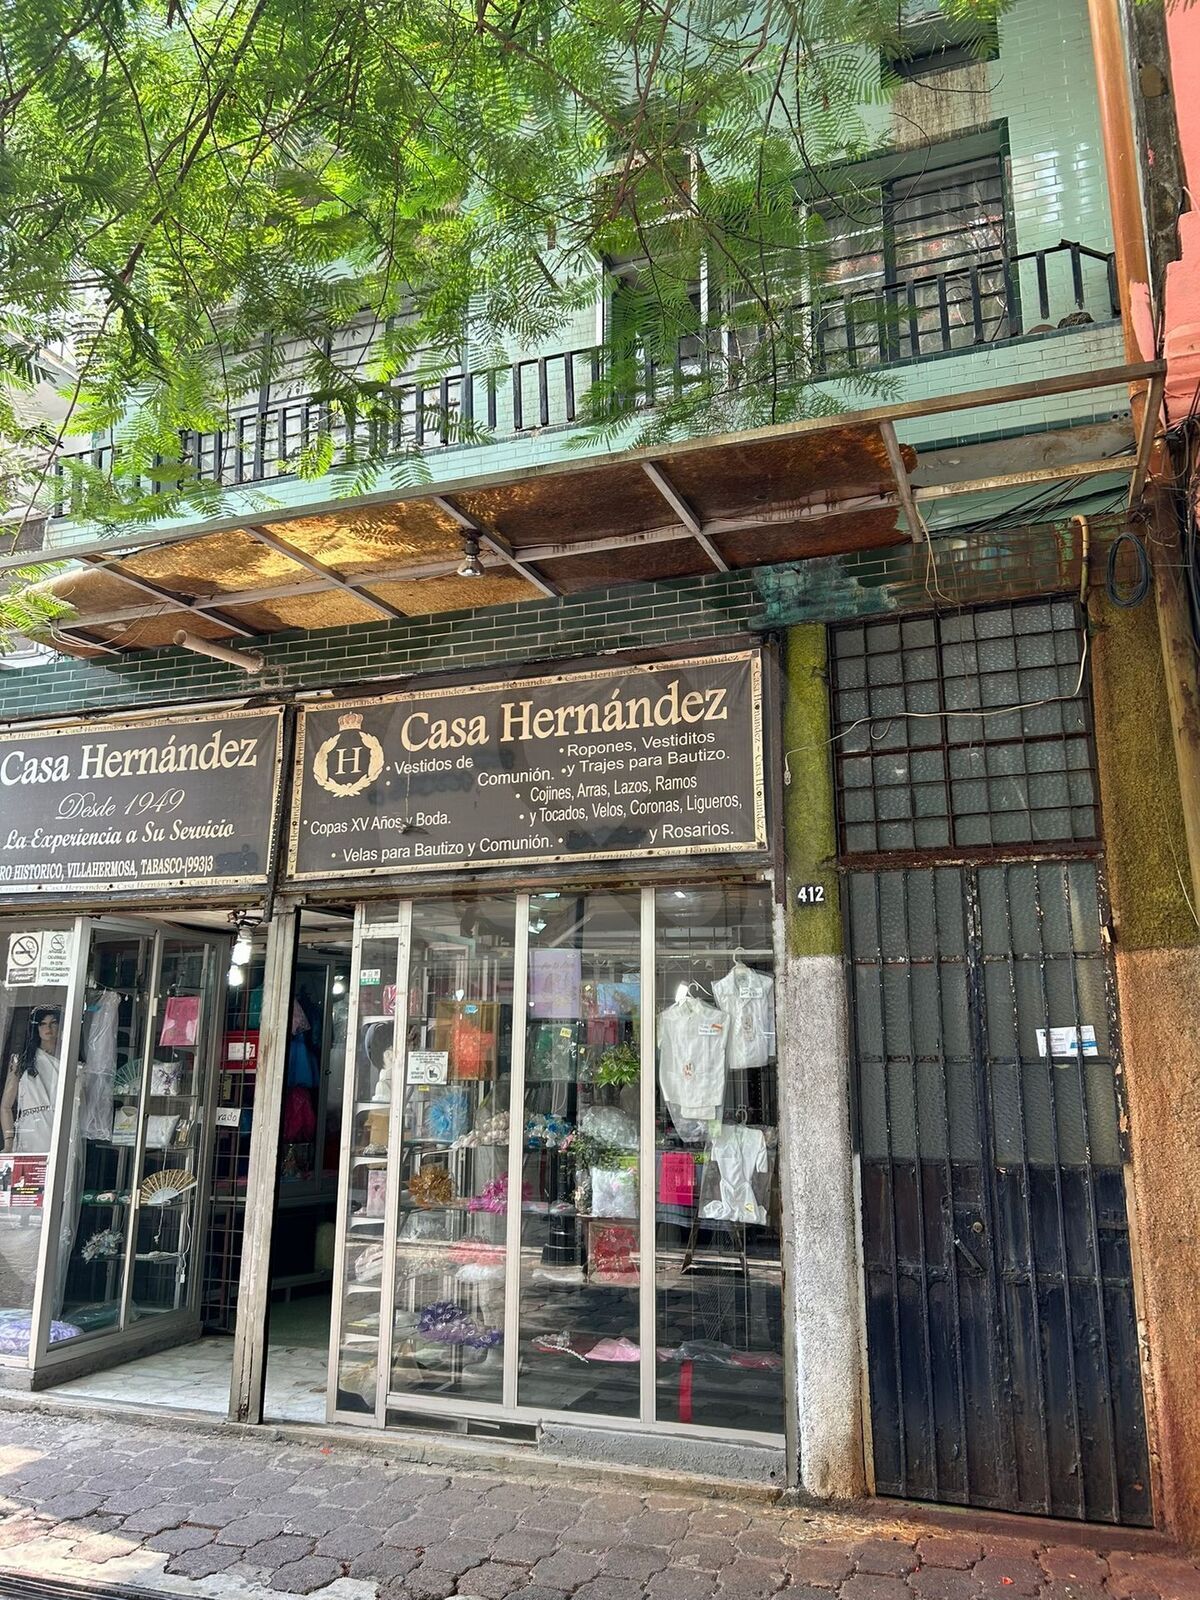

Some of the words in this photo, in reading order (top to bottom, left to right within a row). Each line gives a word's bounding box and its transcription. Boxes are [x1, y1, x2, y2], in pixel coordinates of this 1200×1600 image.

[401, 712, 490, 752] Casa
[500, 680, 728, 742] Hernández
[754, 694, 763, 743] Henández
[1, 751, 70, 785] Casa
[78, 730, 258, 780] Hernández
[567, 742, 637, 757] Ropones,
[642, 731, 716, 749] Vestiditos
[335, 746, 363, 775] H
[394, 757, 451, 774] Vestidos
[456, 755, 473, 769] de
[566, 764, 575, 777] y
[579, 759, 624, 775] Trajes
[629, 756, 662, 775] para
[668, 749, 730, 764] Bautizo.
[478, 768, 554, 786] Comunión.
[530, 785, 575, 805] Cojines,
[577, 782, 610, 798] Arras,
[614, 779, 652, 795] Lazos,
[655, 775, 698, 790] Ramos
[55, 791, 117, 820] Desde
[125, 787, 185, 816] 1949
[529, 811, 537, 827] y
[540, 805, 588, 822] Tocados,
[591, 802, 627, 818] Velos,
[630, 799, 683, 815] Coronas,
[686, 793, 742, 813] Ligueros,
[756, 779, 765, 829] Henández
[3, 829, 26, 850] La
[31, 826, 122, 853] Experiencia
[126, 829, 137, 844] a
[142, 821, 165, 842] Su
[169, 818, 235, 842] Servicio
[310, 820, 348, 837] Copas
[351, 817, 370, 832] XV
[371, 813, 402, 831] Años
[416, 811, 451, 827] Boda.
[649, 828, 658, 843] y
[662, 822, 734, 840] Rosarios.
[343, 847, 378, 862] Velas
[381, 845, 410, 862] para
[415, 841, 464, 857] Bautizo
[467, 841, 476, 857] y
[479, 834, 553, 852] Comunión.
[13, 863, 64, 881] HISTORICO,
[67, 860, 138, 878] VILLAHERMOSA,
[797, 885, 825, 903] 412
